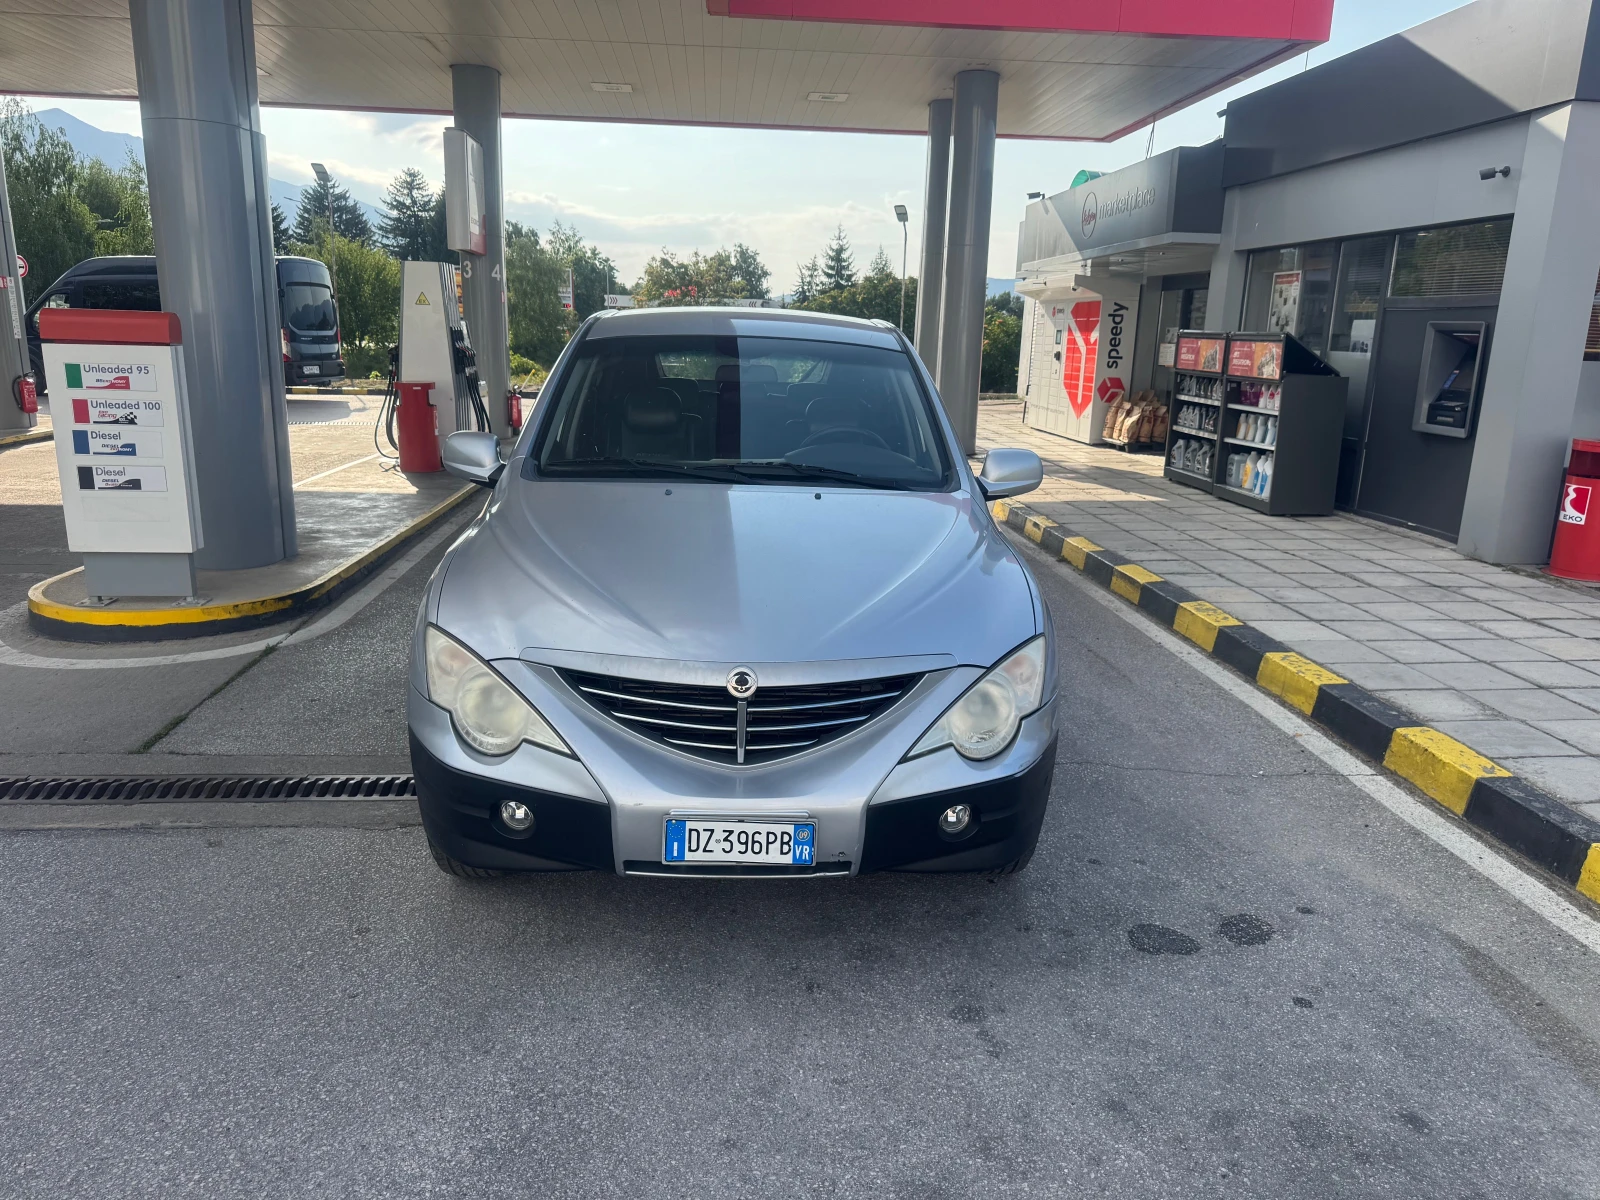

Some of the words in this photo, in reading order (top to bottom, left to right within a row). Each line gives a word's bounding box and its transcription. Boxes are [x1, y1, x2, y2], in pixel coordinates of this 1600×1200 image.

[1099, 187, 1155, 219] marketplace
[463, 261, 472, 278] 3
[491, 264, 501, 281] 4
[1107, 302, 1128, 369] speedy
[84, 364, 133, 374] Unleaded
[136, 366, 150, 374] 95
[90, 400, 140, 410] Unleaded
[143, 402, 160, 410] 100
[90, 431, 121, 440] Diesel
[96, 466, 126, 476] Diesel
[1563, 514, 1582, 522] EKO
[800, 830, 808, 839] 09
[795, 845, 810, 860] VR
